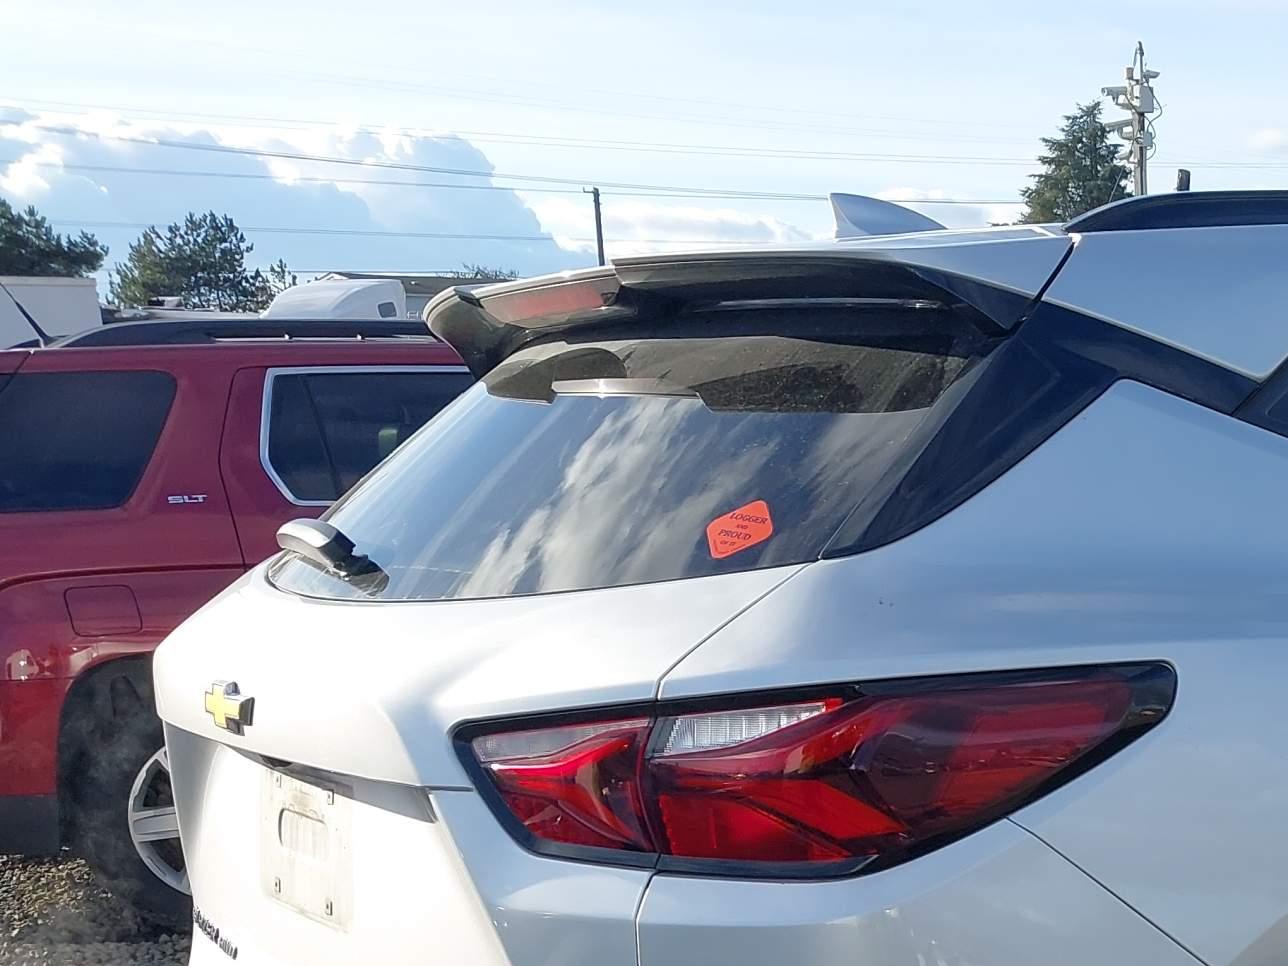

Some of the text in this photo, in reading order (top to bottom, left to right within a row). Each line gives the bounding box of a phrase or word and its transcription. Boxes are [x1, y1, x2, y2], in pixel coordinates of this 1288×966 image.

[167, 494, 208, 504] SLT
[729, 512, 768, 525] LOGGER
[718, 529, 752, 541] PROUD
